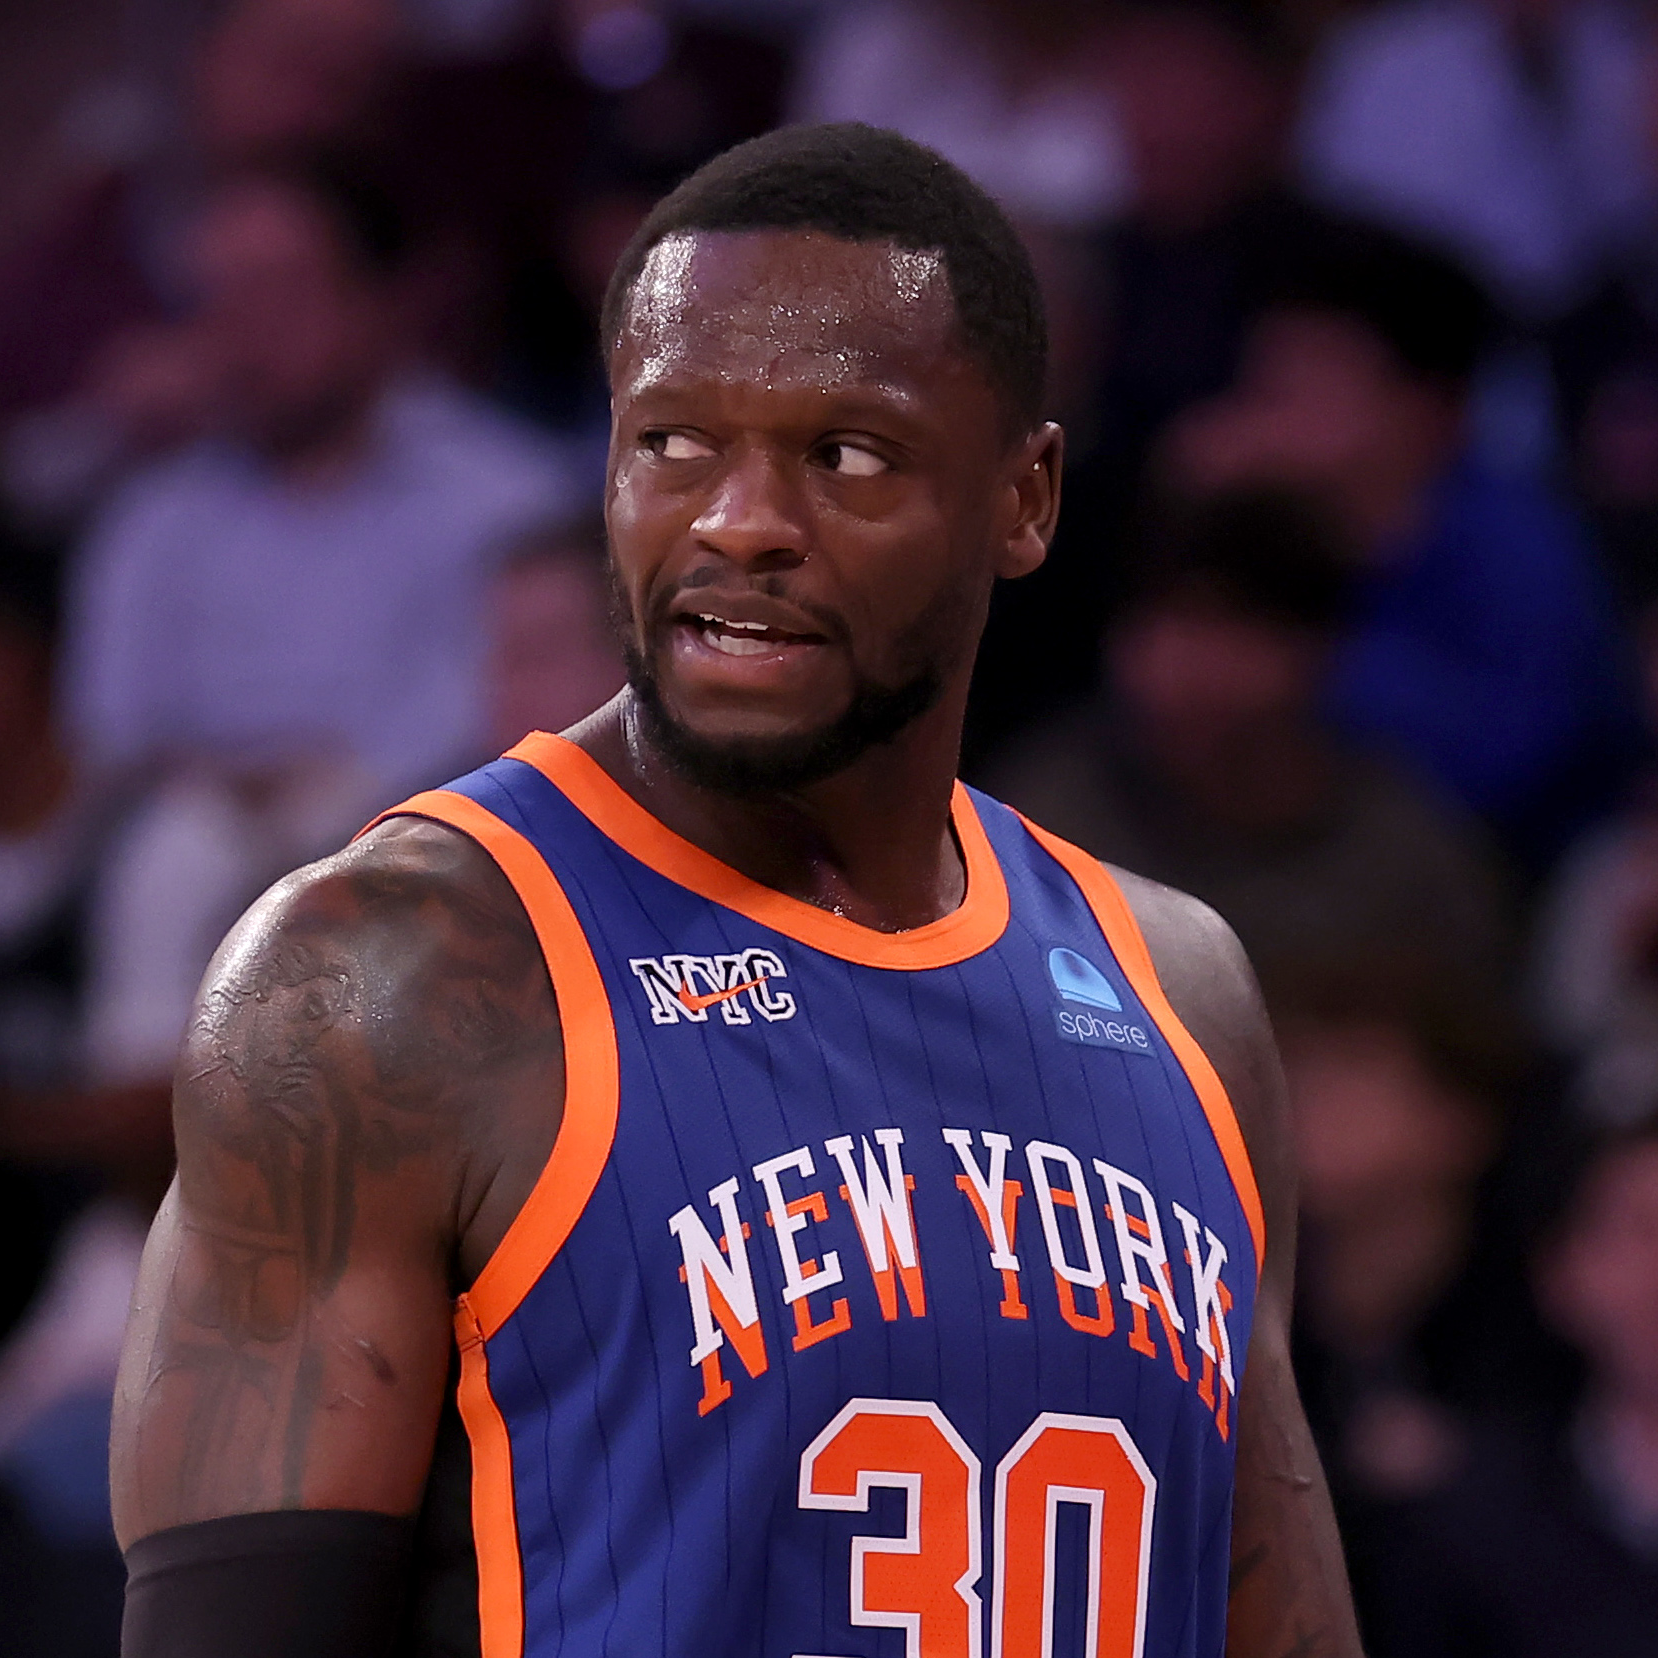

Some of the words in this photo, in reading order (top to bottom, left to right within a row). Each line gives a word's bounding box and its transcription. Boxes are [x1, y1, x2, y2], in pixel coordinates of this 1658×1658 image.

[629, 947, 798, 1025] NYC
[1059, 1012, 1148, 1048] sphere
[668, 1127, 921, 1372] NEW
[941, 1127, 1235, 1398] YORK
